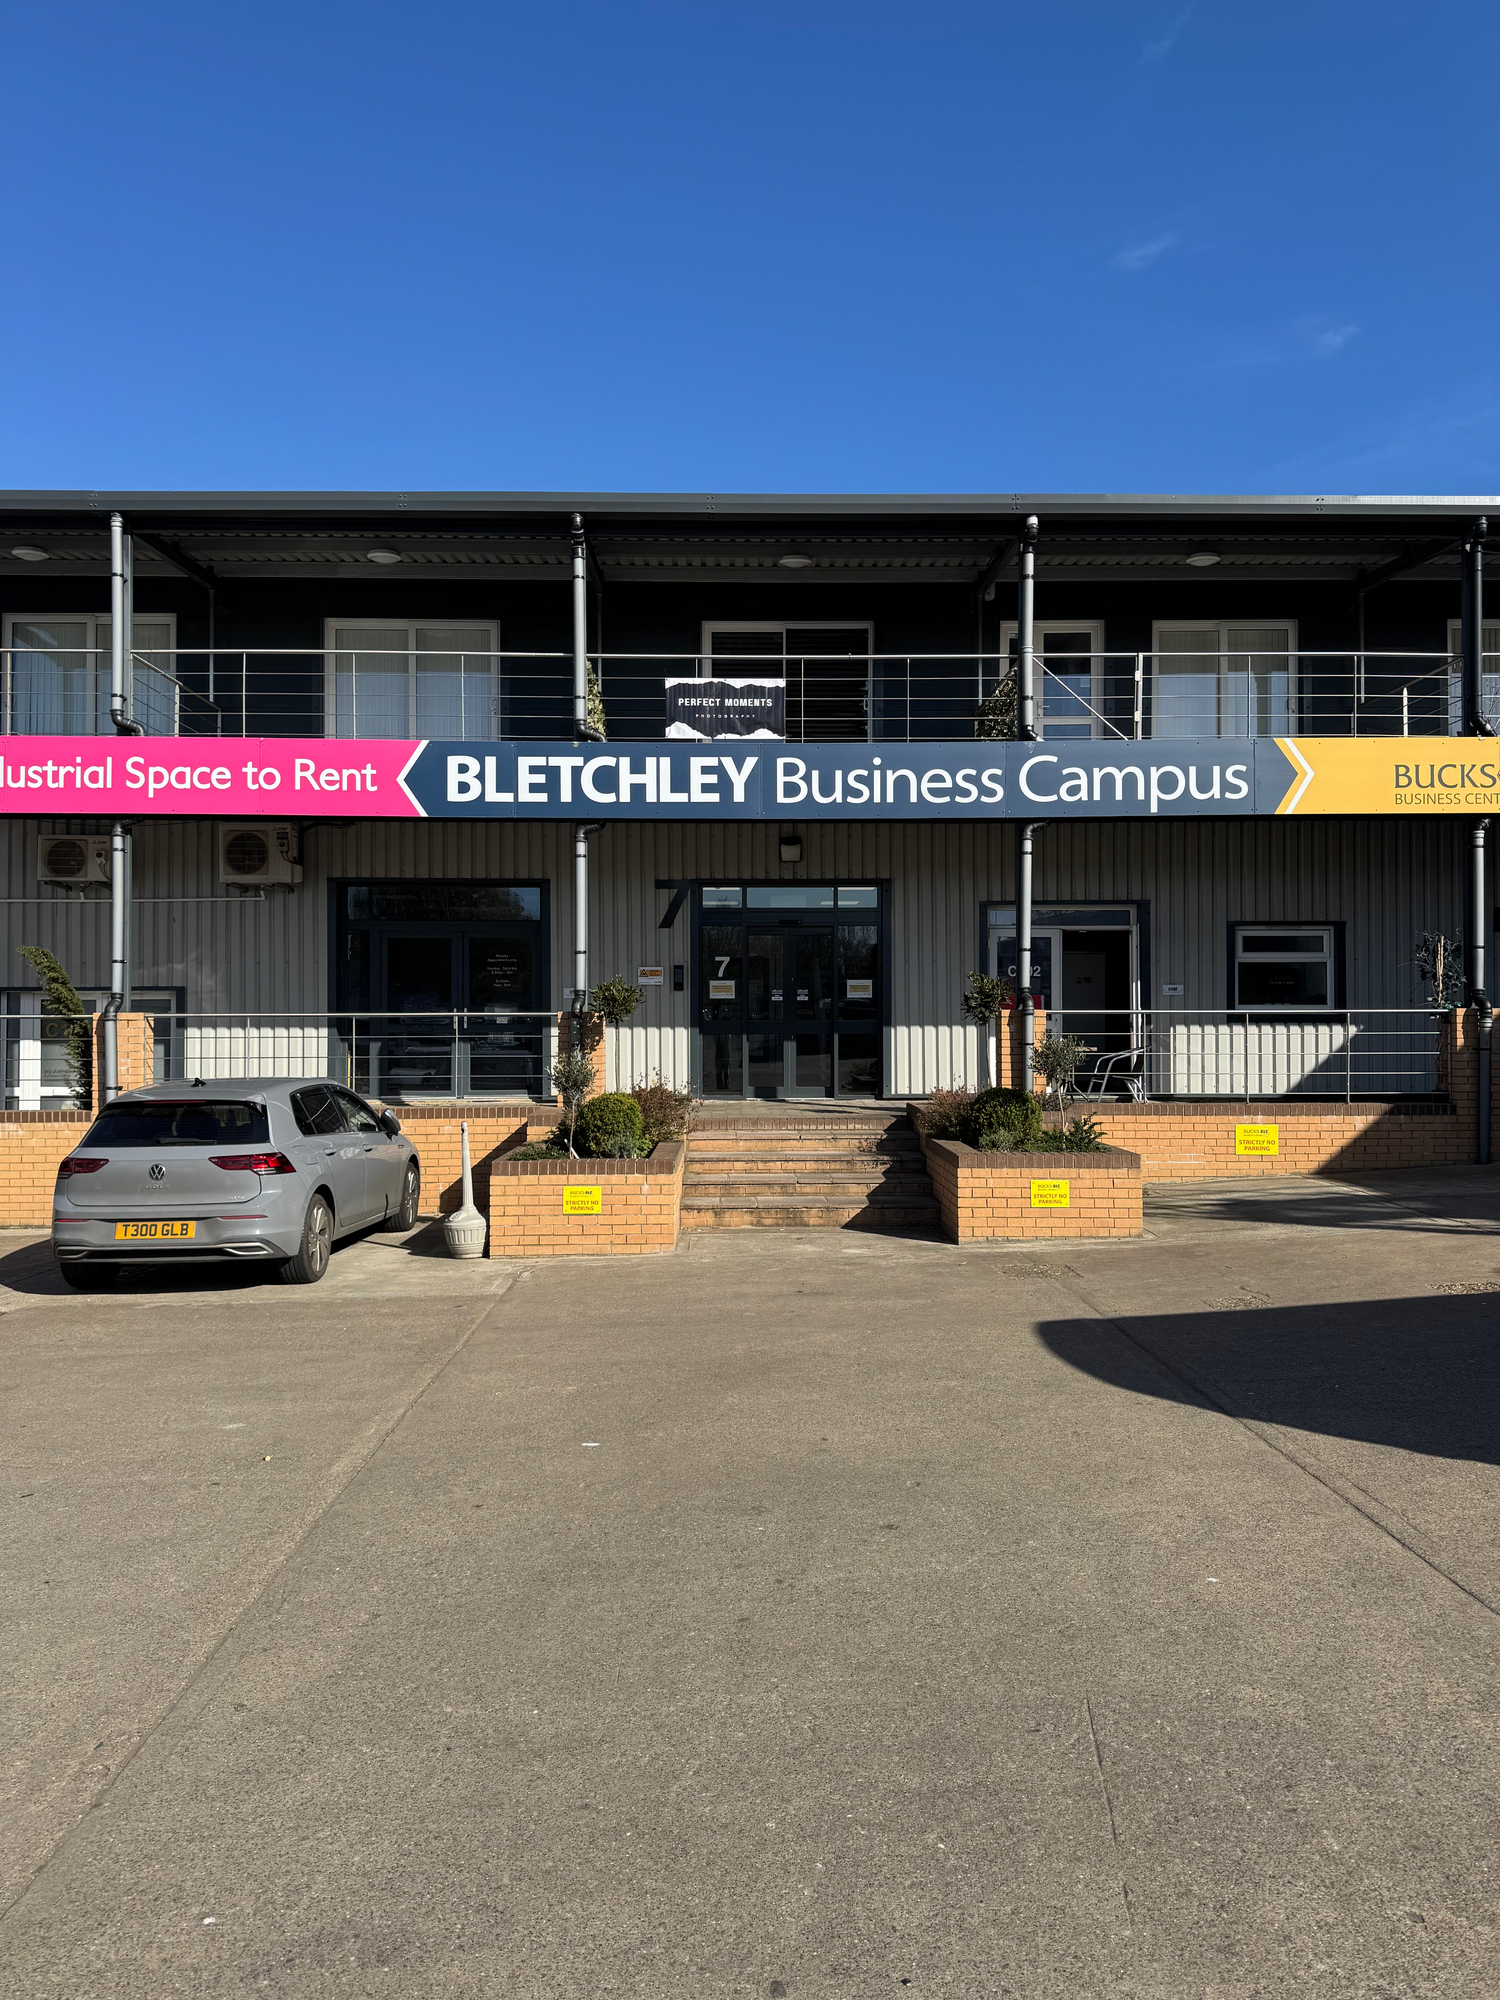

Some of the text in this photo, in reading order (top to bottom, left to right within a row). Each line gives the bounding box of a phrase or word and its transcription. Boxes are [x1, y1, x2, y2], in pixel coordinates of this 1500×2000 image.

[678, 698, 773, 707] PERFECT MOMENTS
[125, 756, 231, 797] Space
[242, 761, 281, 790] to
[294, 758, 377, 792] Rent
[446, 753, 1248, 814] BLETCHLEY Business Campus
[1395, 793, 1461, 805] BUSINESS
[715, 956, 730, 978] 7
[122, 1223, 189, 1237] T300 GLB
